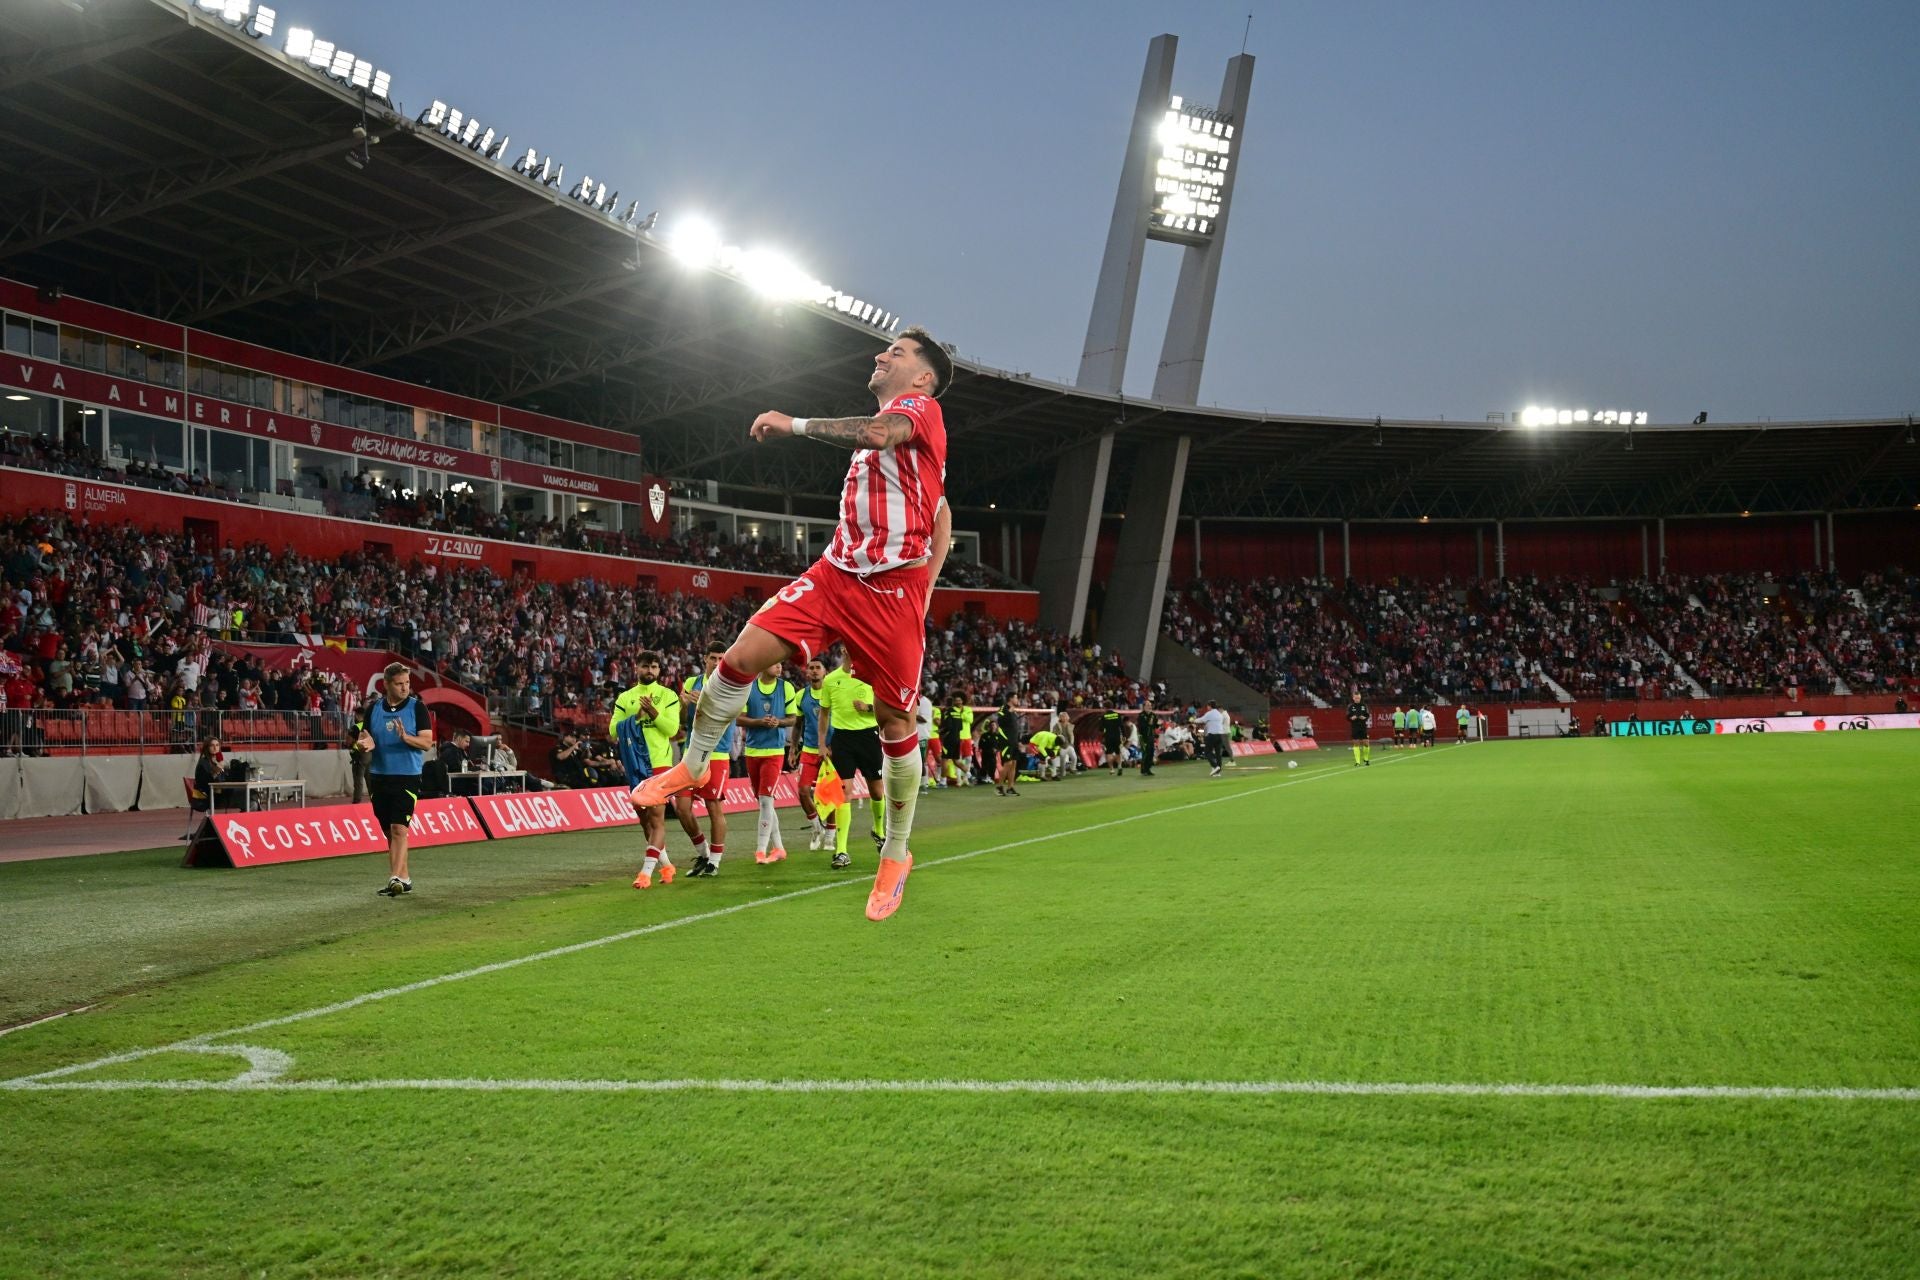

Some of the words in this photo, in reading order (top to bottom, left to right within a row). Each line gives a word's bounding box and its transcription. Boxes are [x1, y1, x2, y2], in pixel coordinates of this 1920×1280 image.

[108, 384, 278, 434] ALMERÍA
[352, 435, 389, 456] ALMERÍA
[390, 441, 417, 461] NUNCA
[417, 450, 431, 462] SE
[84, 487, 127, 505] ALMERÍA
[543, 474, 568, 488] VAMOS
[568, 479, 599, 493] ALMERÍA
[1614, 720, 1685, 736] LALIGA
[490, 796, 570, 832] LALIGA
[580, 789, 638, 823] LALIG
